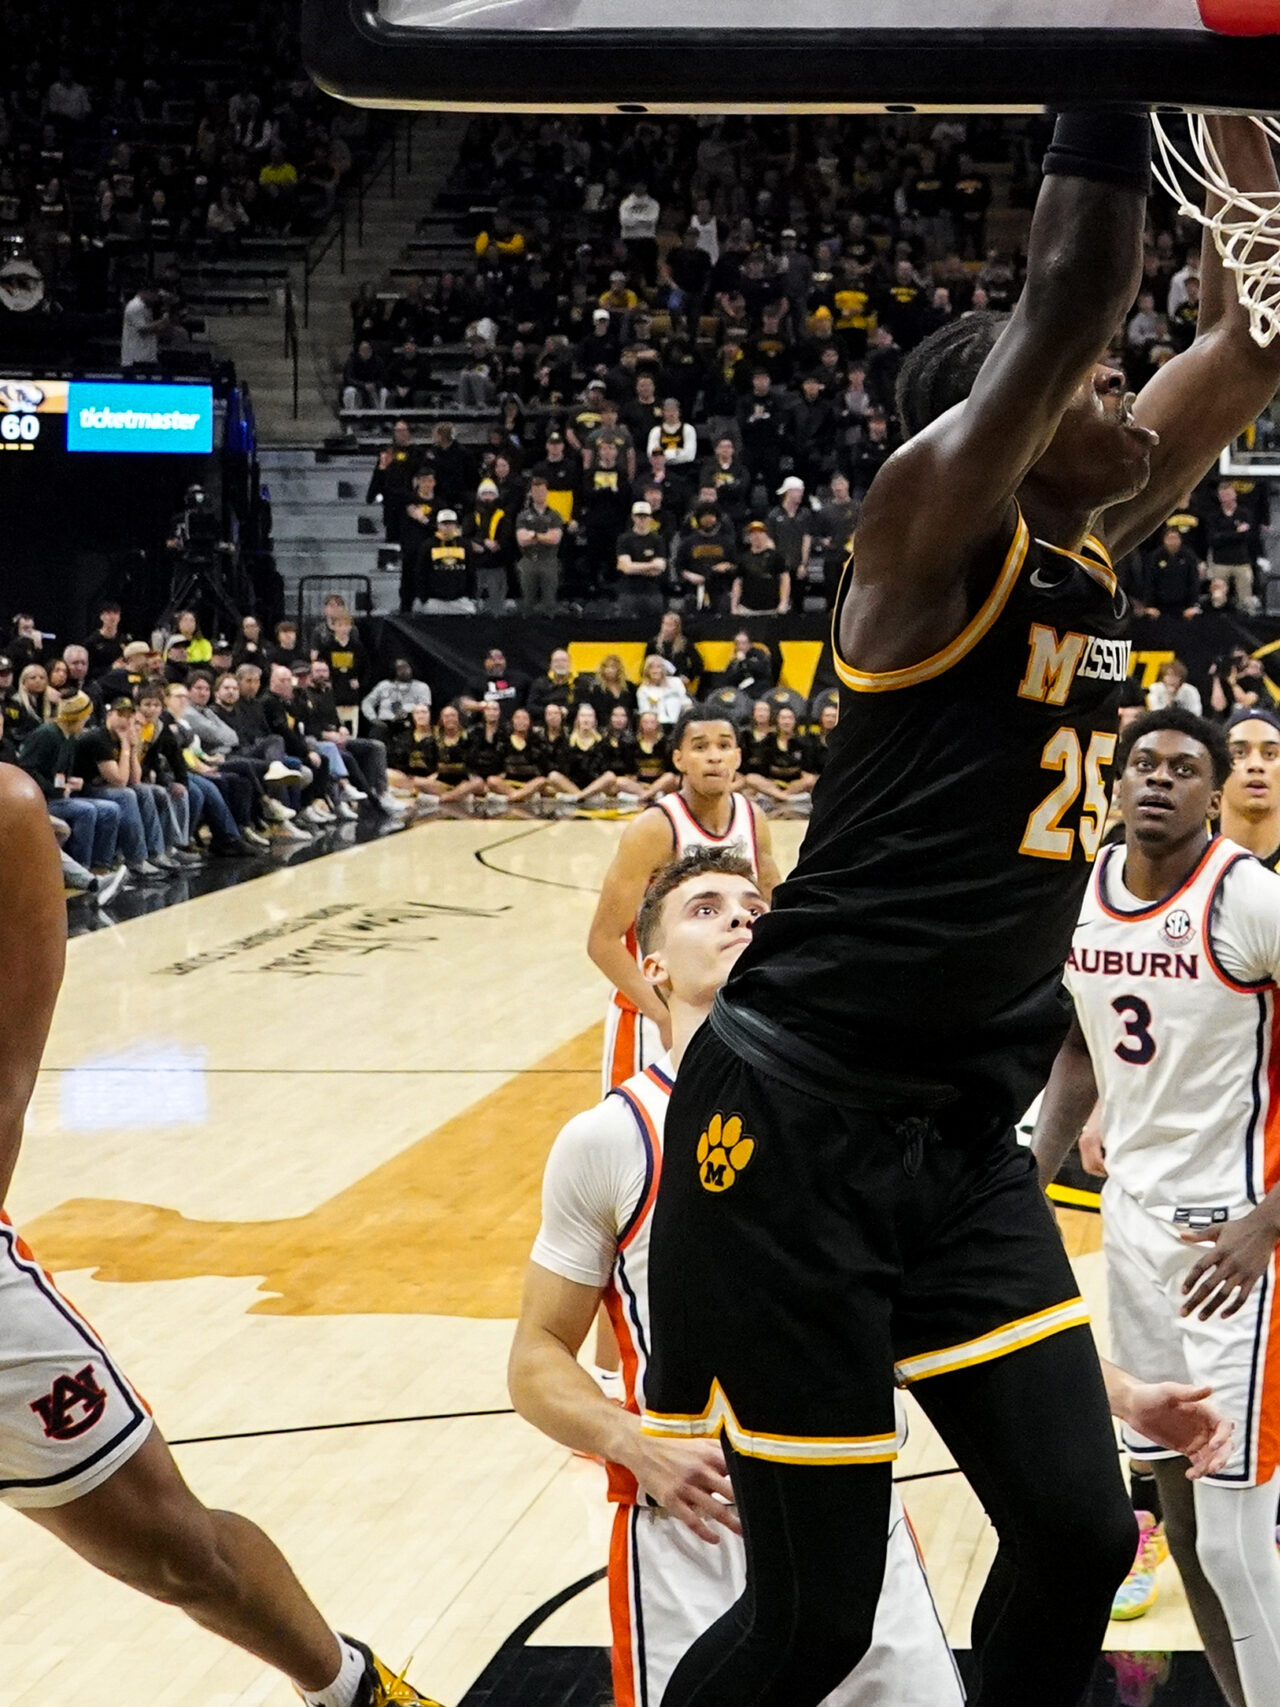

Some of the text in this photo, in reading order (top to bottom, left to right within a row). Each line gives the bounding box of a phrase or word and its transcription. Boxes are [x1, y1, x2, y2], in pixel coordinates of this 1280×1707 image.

[1, 415, 40, 440] 60
[79, 406, 200, 430] ticketmaster
[1018, 726, 1118, 863] 25
[1067, 946, 1199, 980] AUBURN
[1111, 994, 1157, 1066] 3
[704, 1160, 727, 1188] M
